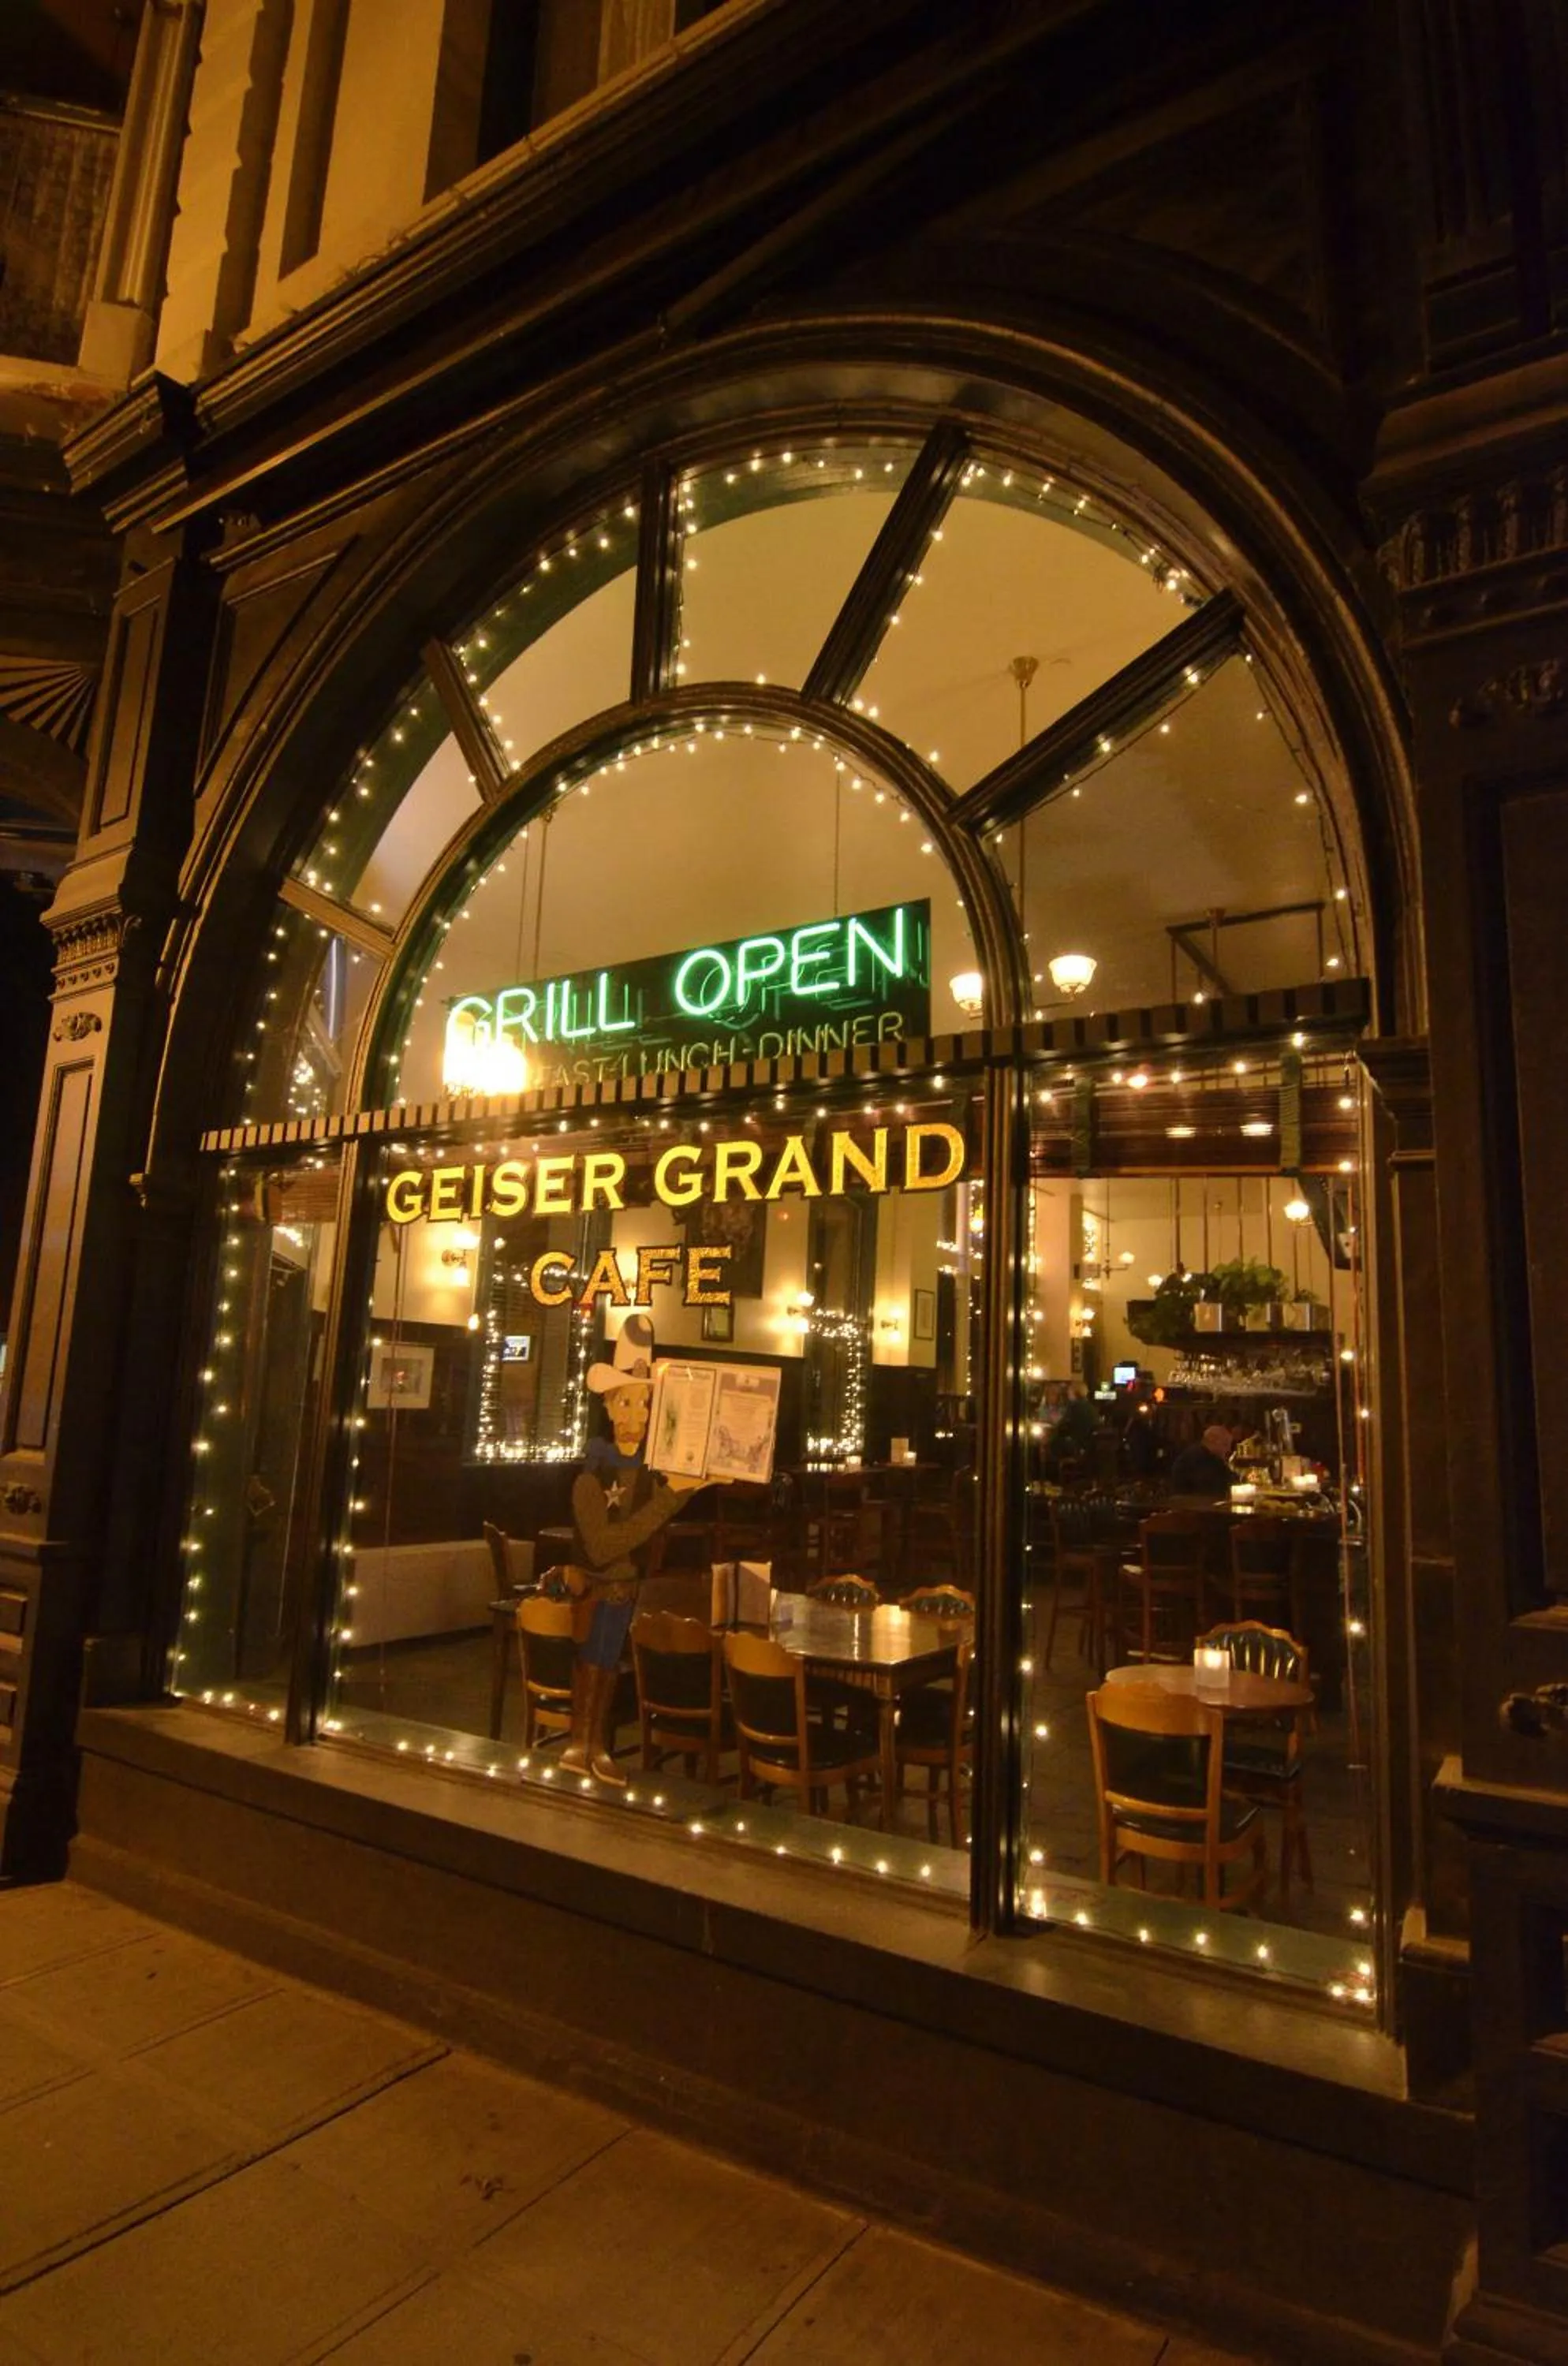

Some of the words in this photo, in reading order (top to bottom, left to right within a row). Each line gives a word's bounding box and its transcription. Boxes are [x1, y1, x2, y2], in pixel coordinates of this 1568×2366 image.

[445, 972, 636, 1054] GRILL
[675, 907, 905, 1015] OPEN
[386, 1151, 625, 1225] GEISER
[654, 1122, 966, 1207] GRAND
[529, 1245, 732, 1307] CAFE
